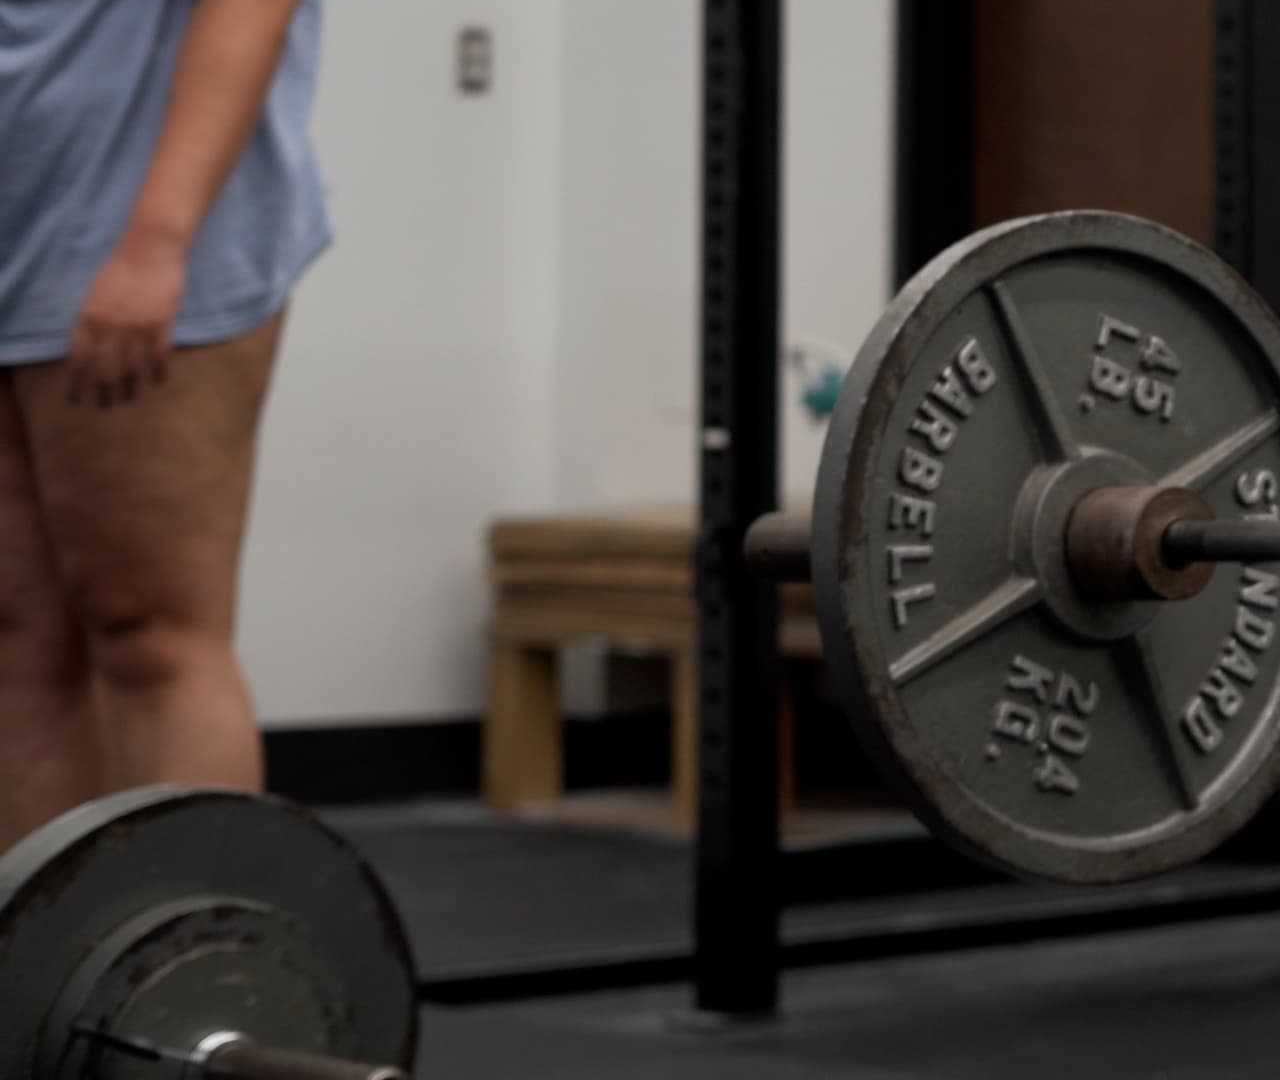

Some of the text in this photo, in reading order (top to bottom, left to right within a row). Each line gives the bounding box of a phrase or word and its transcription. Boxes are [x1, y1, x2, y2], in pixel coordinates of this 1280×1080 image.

[1081, 316, 1139, 414] LB.
[1133, 335, 1181, 420] 45
[886, 338, 997, 625] BARBELL
[1183, 469, 1280, 753] STNDARD
[985, 655, 1055, 760] KG.
